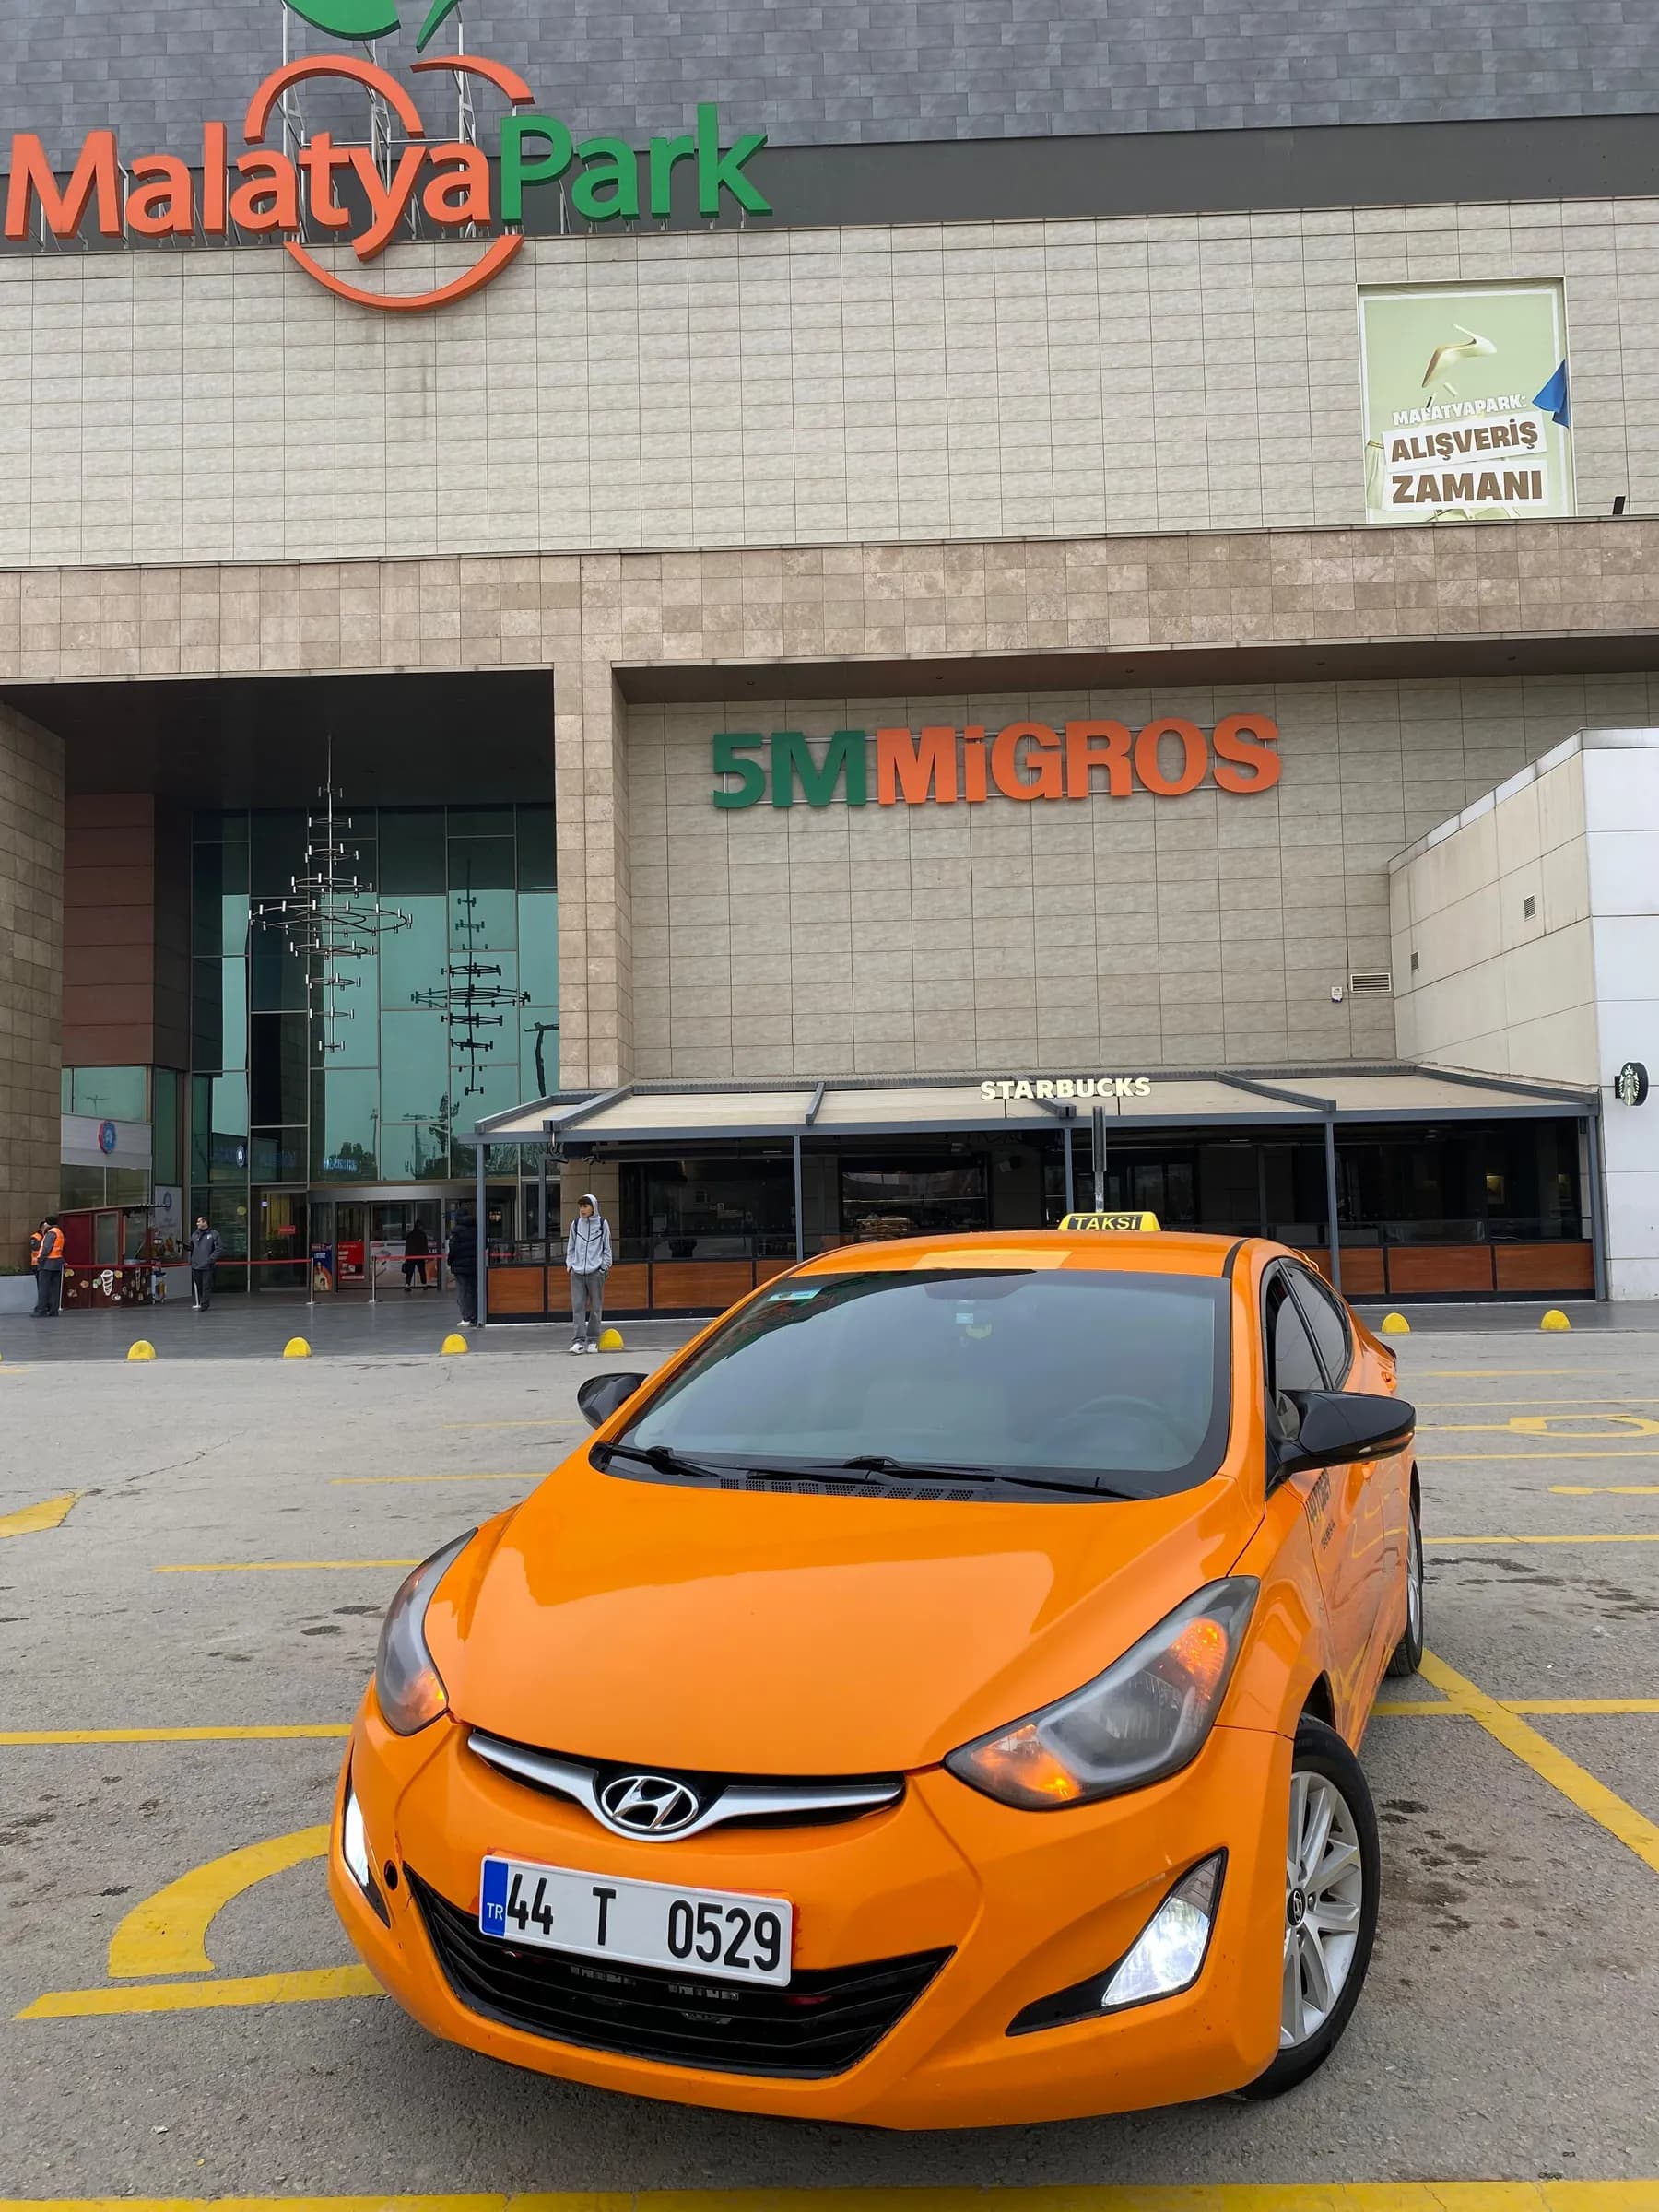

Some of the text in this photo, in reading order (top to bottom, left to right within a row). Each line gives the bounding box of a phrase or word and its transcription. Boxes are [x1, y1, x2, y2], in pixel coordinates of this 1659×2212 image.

[1393, 394, 1527, 426] MALATYAPARK:
[1391, 418, 1538, 462] ALIŞVERİŞ
[1392, 470, 1543, 504] ZAMANI
[981, 1077, 1151, 1100] STARBUCKS
[486, 1901, 504, 1922] TR
[507, 1873, 782, 1971] 44 T 0529
